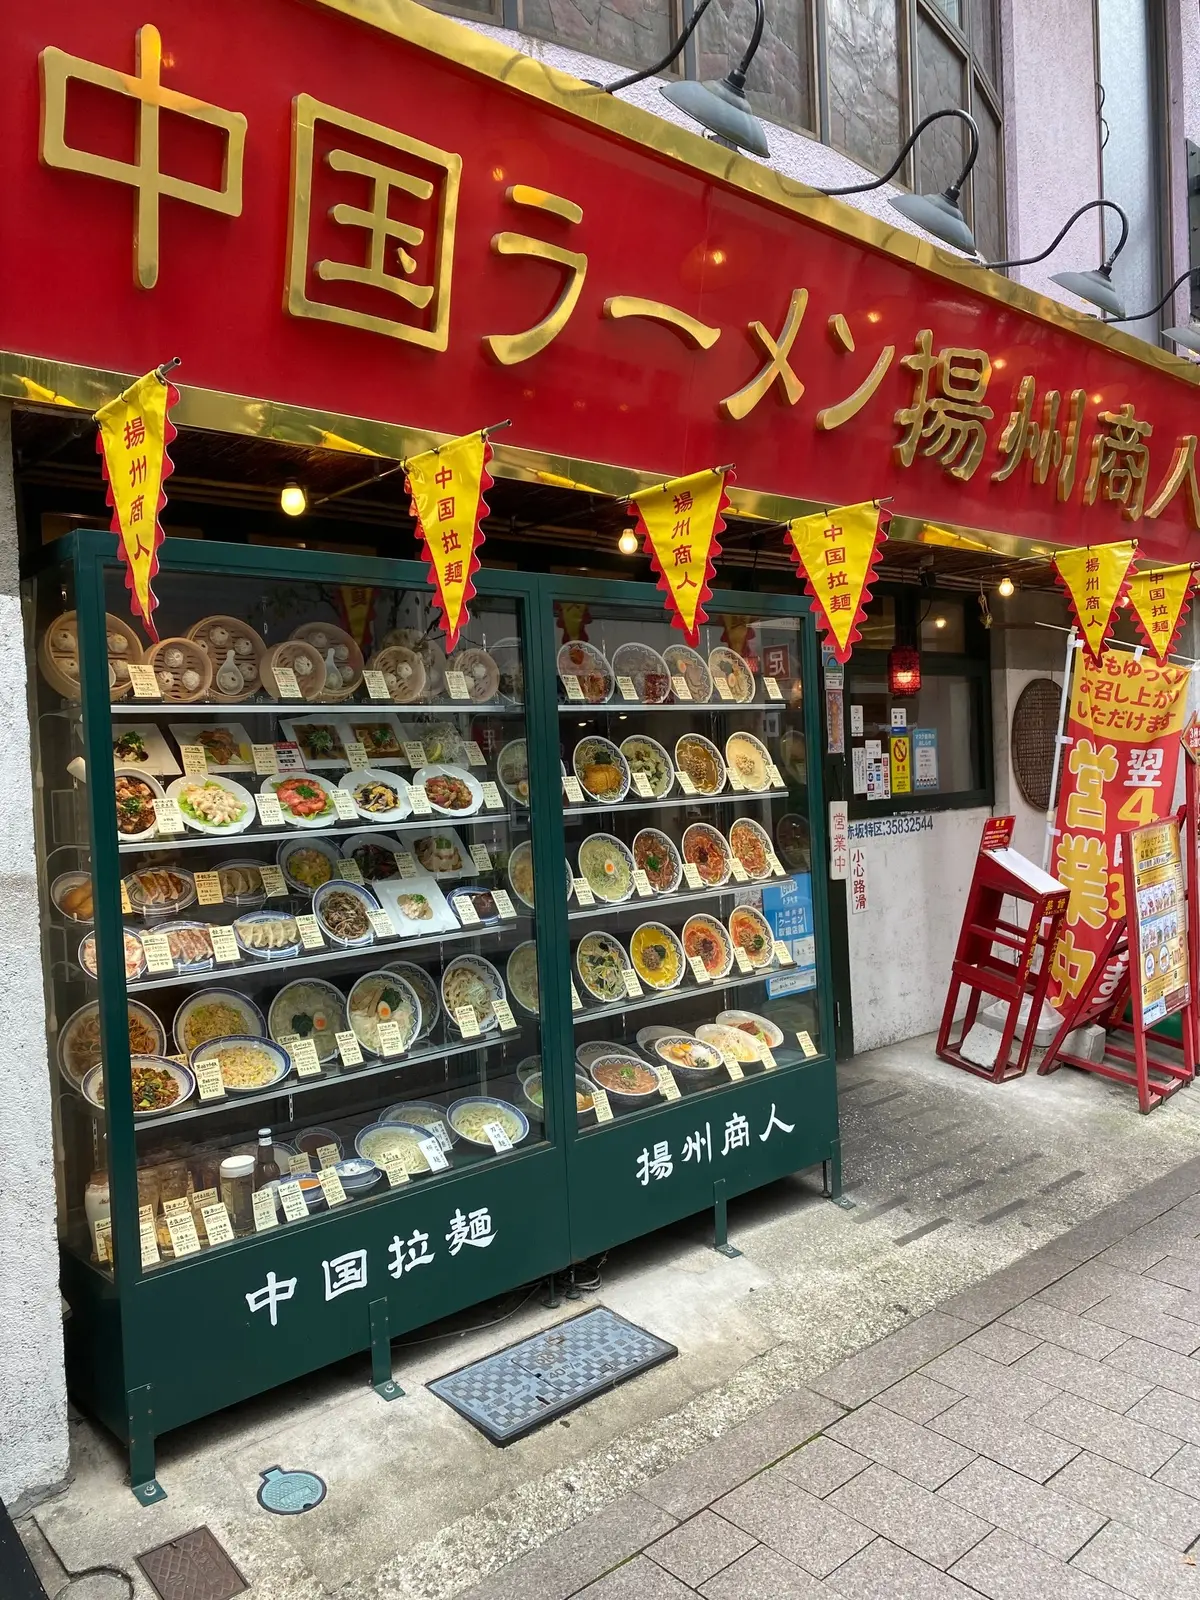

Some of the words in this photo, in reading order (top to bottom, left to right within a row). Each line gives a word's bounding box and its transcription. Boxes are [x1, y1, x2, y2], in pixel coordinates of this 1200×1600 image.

[123, 415, 151, 561] 揚州商人
[434, 464, 465, 588] 中国拉麺
[670, 489, 698, 591] 揚州商人
[822, 523, 853, 614] 中国拉麺
[1084, 556, 1104, 631] 揚州商人
[1147, 571, 1170, 635] 中国拉麺
[833, 812, 847, 874] 営業中
[852, 848, 866, 911] 小心路滑
[1049, 738, 1120, 1008] 営業中
[636, 1102, 796, 1187] 揚州商人
[245, 1206, 499, 1328] 中国拉麺
